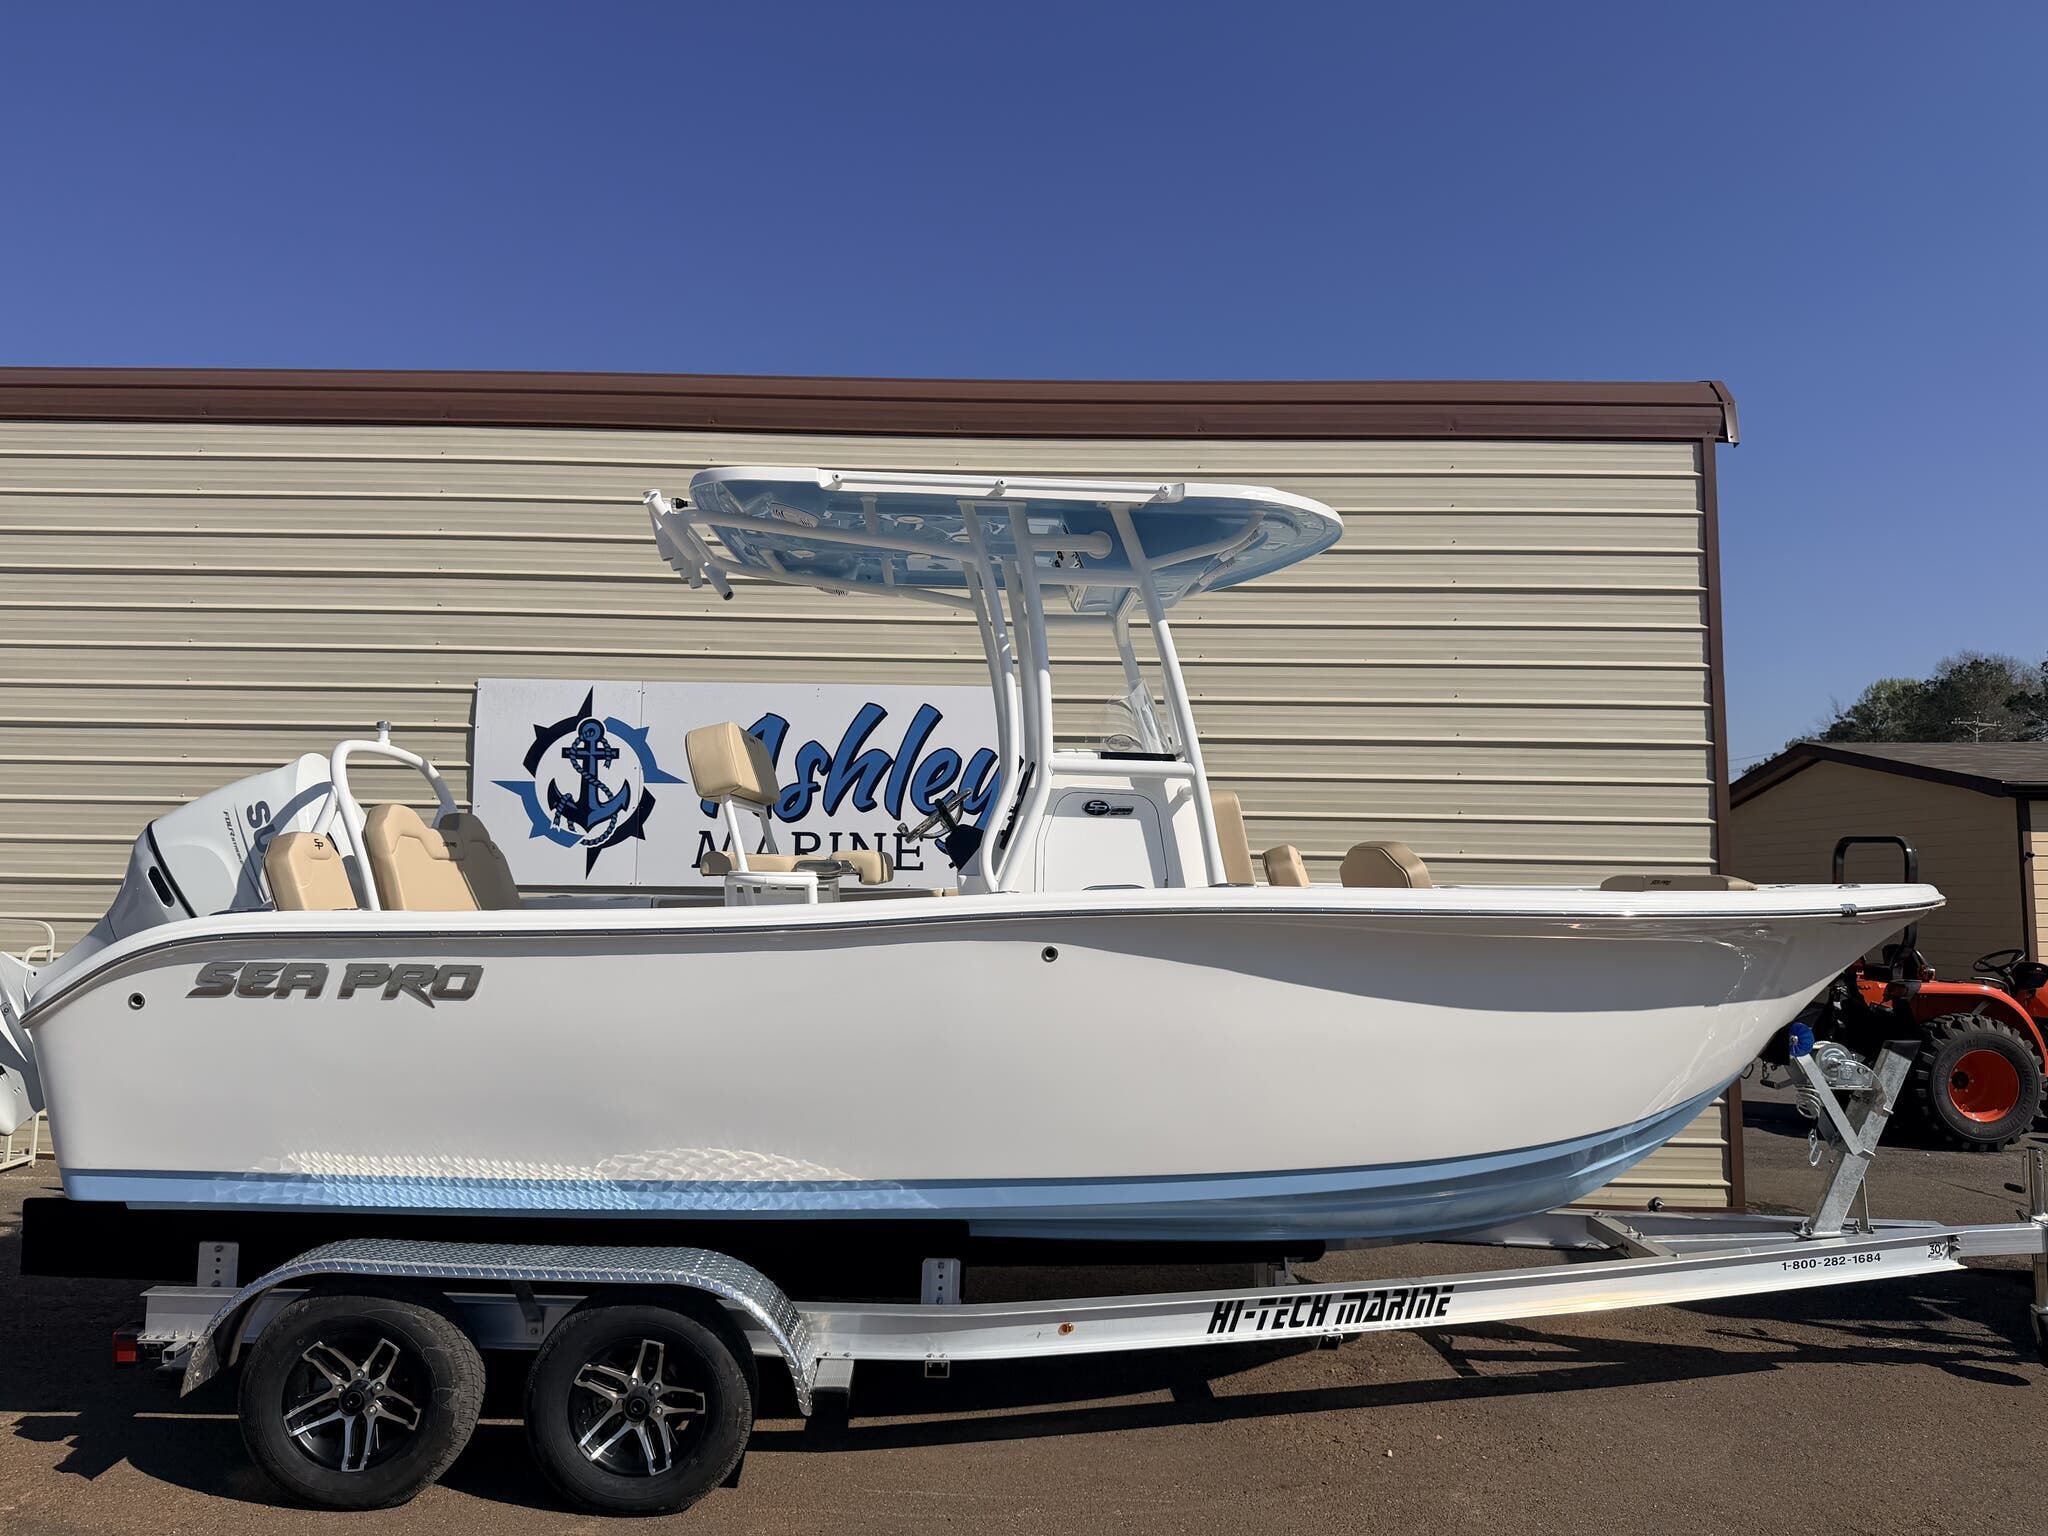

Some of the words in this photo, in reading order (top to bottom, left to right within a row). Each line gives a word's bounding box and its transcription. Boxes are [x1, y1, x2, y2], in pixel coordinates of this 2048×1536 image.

[185, 962, 329, 999] SEA
[337, 963, 484, 1008] PRO
[1782, 1253, 1881, 1271] 1-800-282-1684
[1207, 1293, 1332, 1334] HI-TECH
[1335, 1284, 1454, 1325] MARINE
